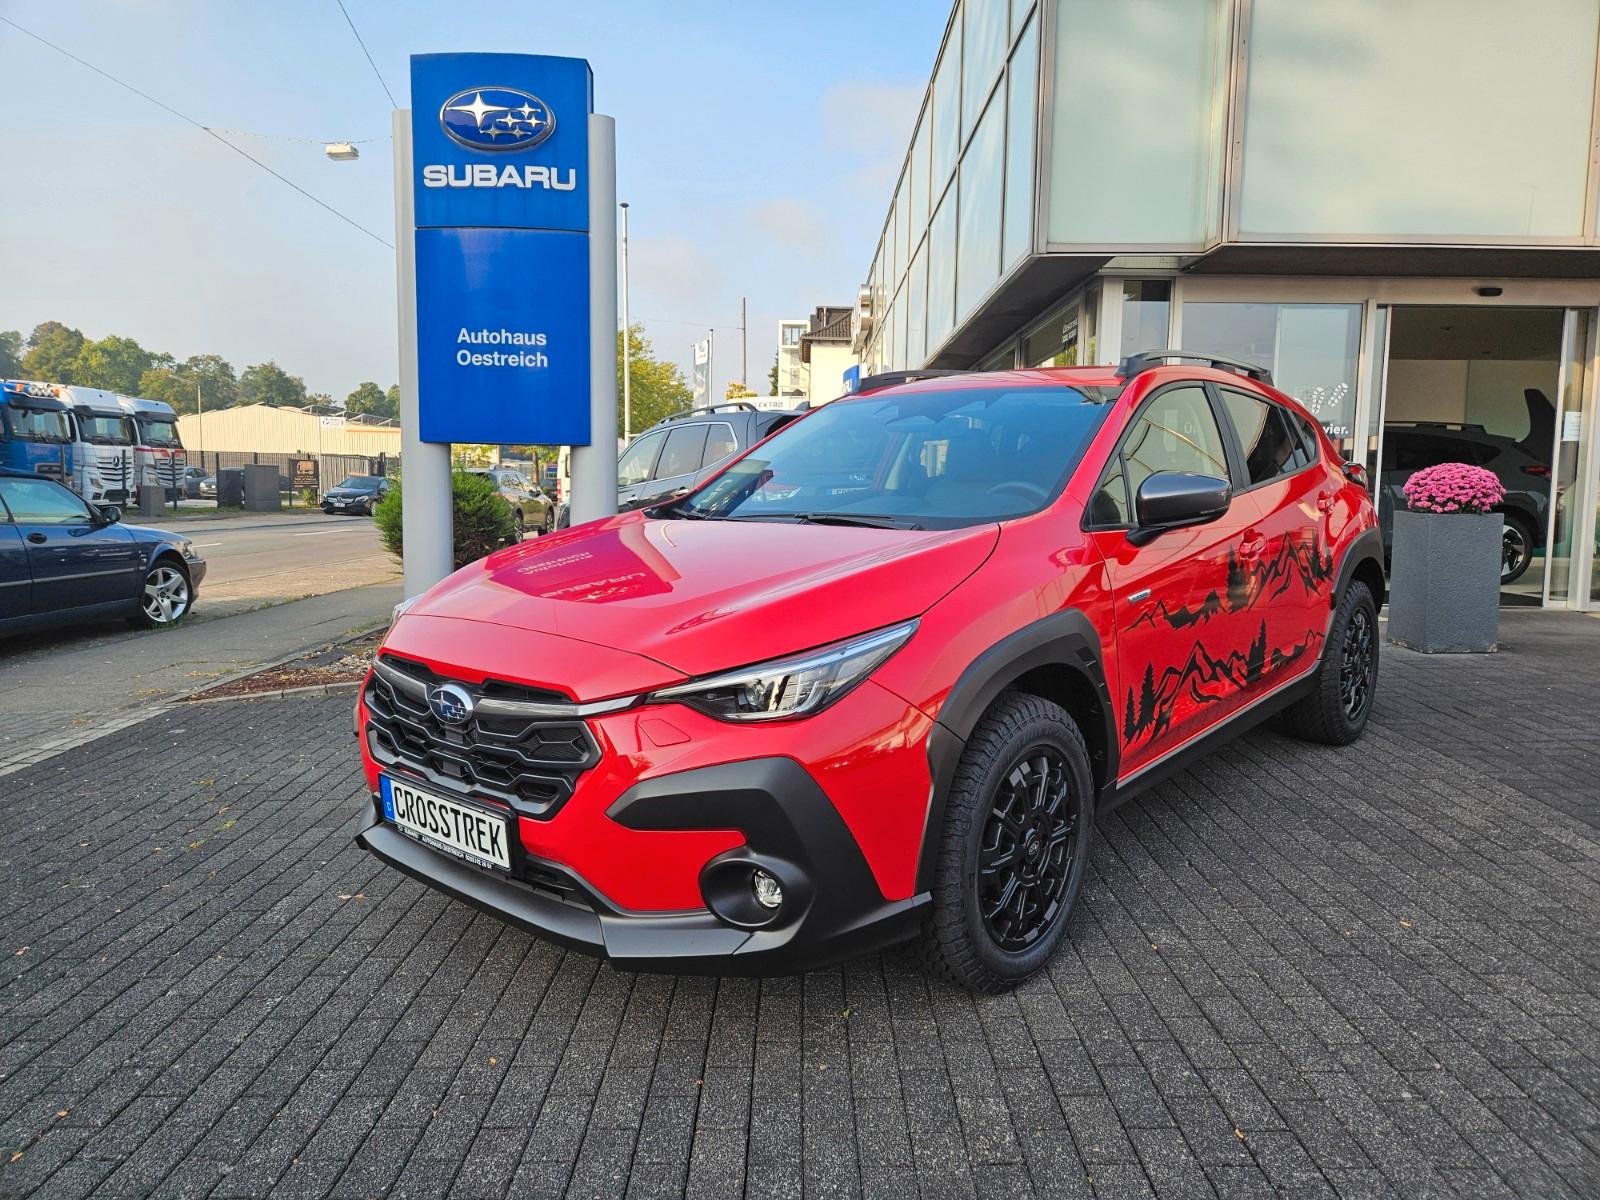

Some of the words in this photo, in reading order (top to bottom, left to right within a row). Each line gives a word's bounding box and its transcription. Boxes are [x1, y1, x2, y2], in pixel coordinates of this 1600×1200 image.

[423, 164, 577, 191] SUBARU
[457, 327, 547, 346] Autohaus
[456, 349, 548, 367] Oestreich
[752, 401, 784, 409] LEKTRO
[394, 786, 504, 861] CROSSTREK
